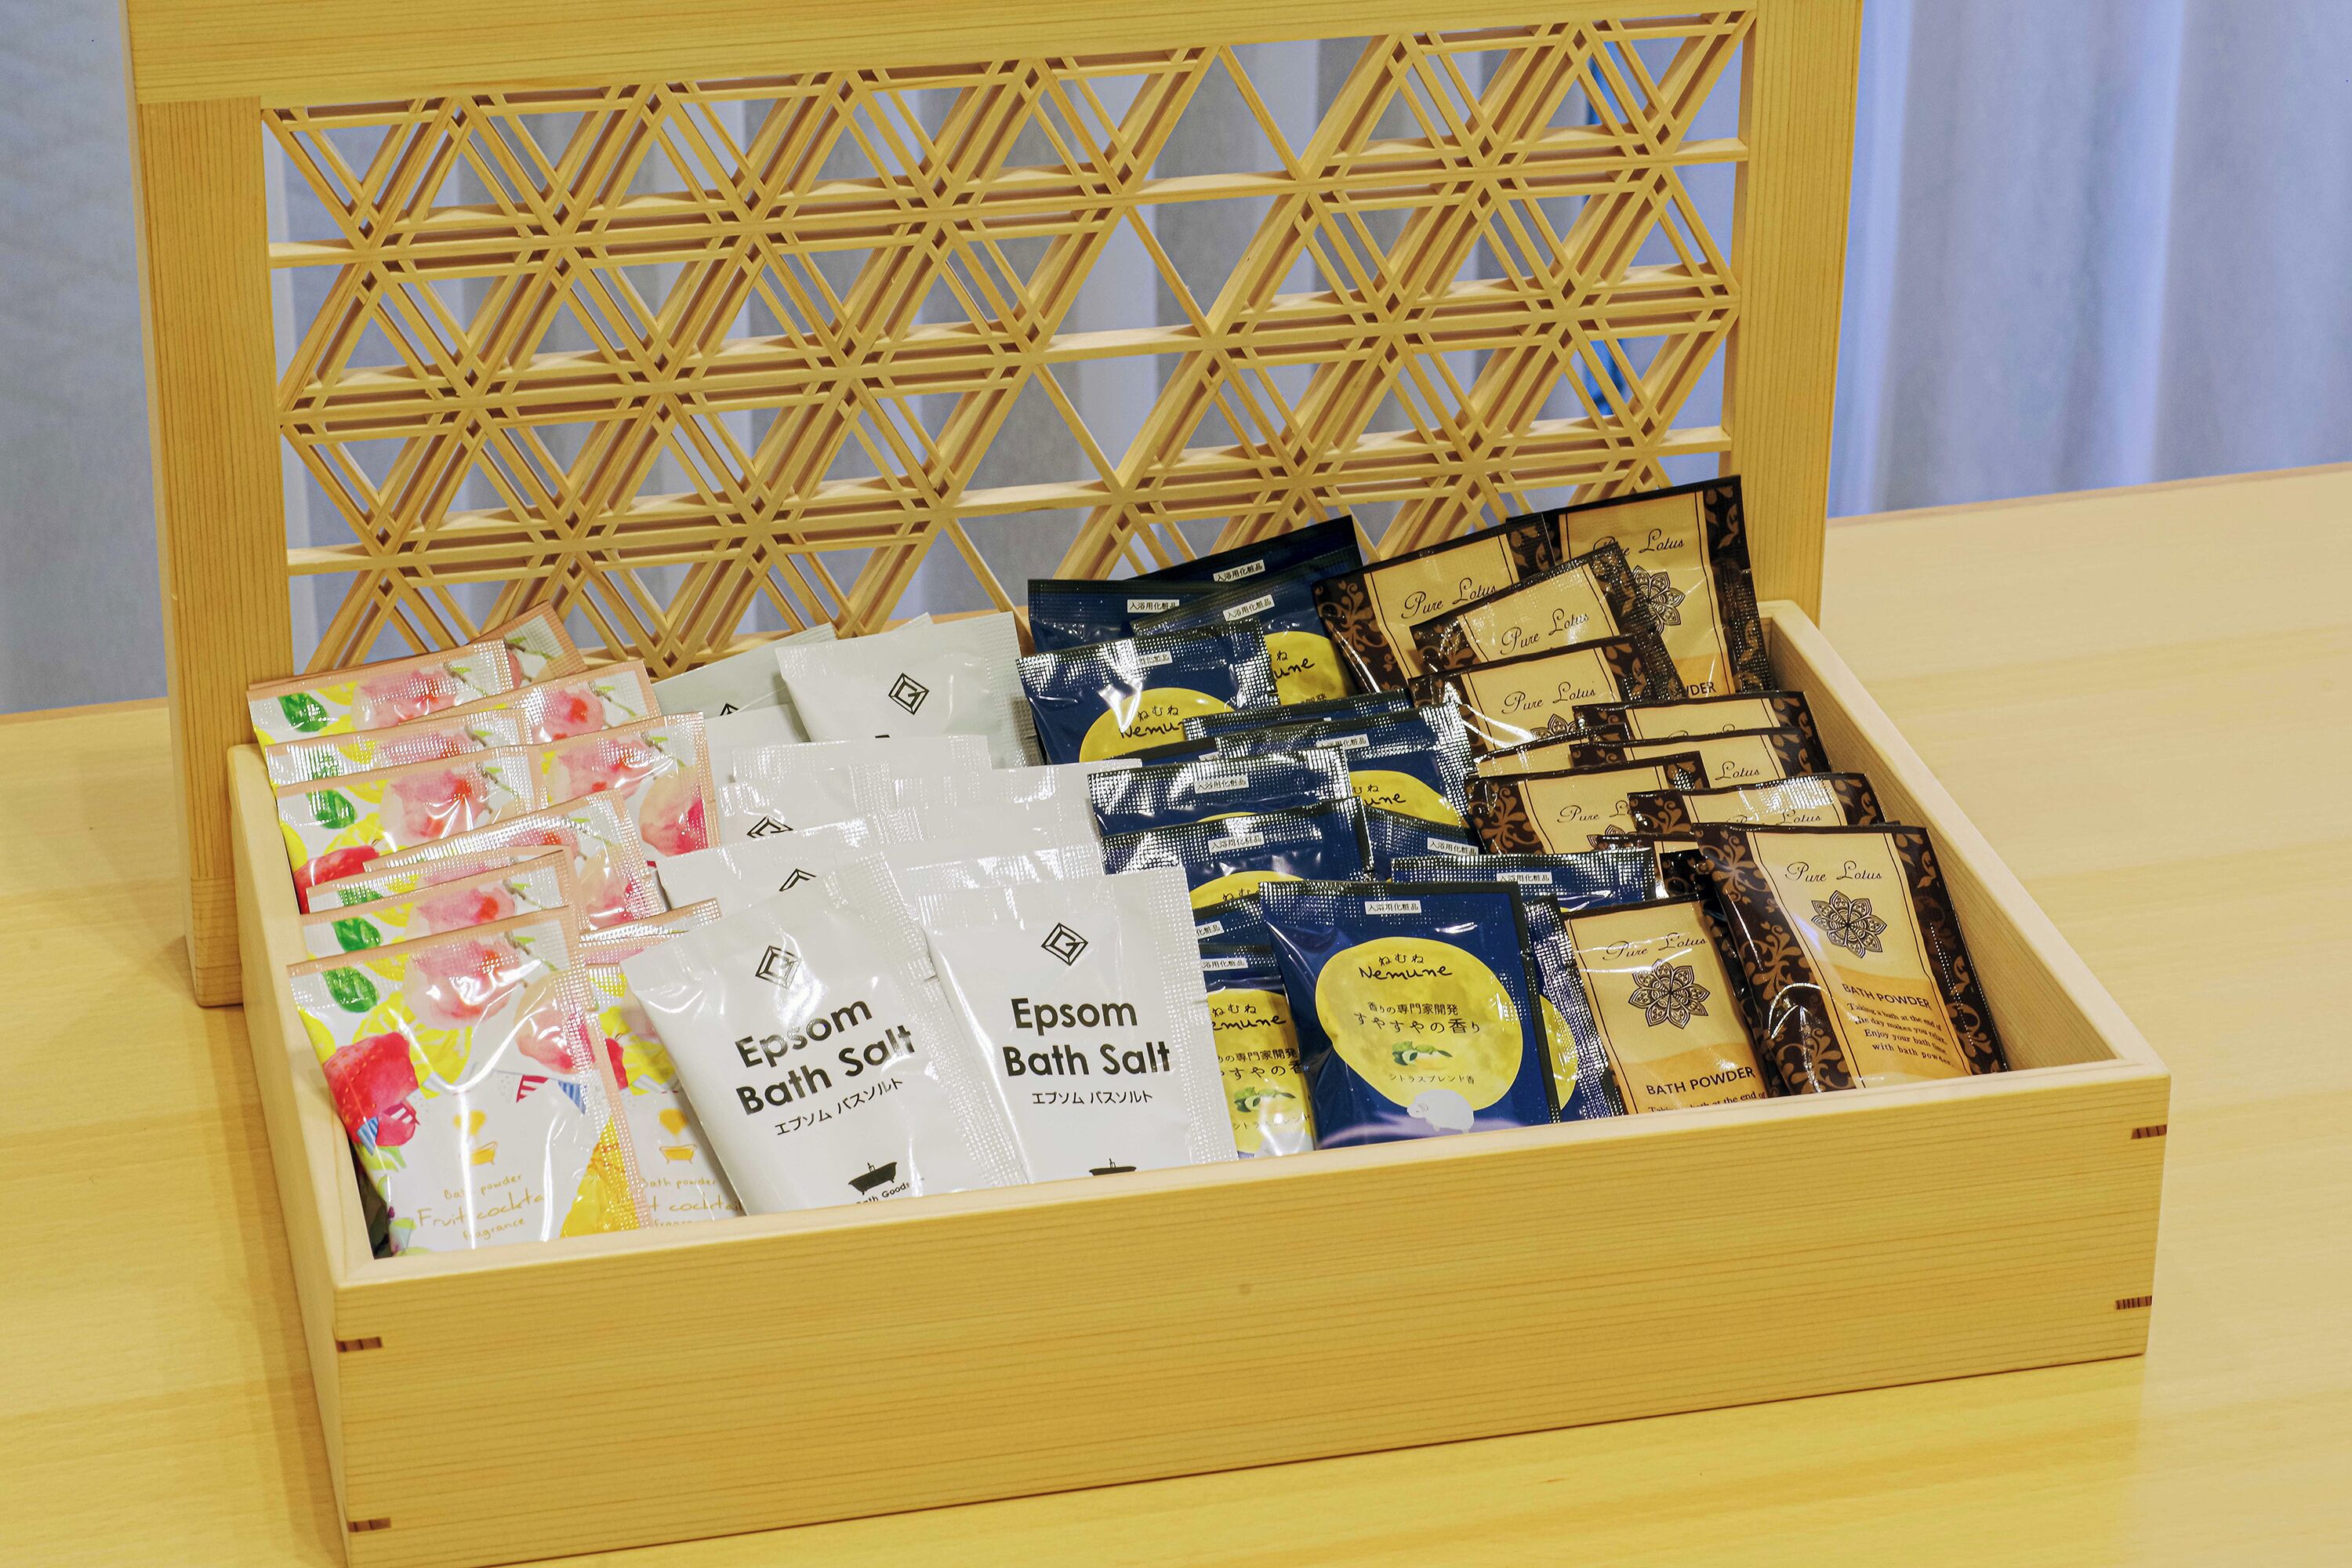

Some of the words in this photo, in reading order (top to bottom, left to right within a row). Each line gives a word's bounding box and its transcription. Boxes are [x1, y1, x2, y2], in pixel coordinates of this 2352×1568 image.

[1639, 528, 1685, 554] Lotus
[1227, 598, 1272, 619] 入浴用化粧品
[1401, 591, 1443, 619] Pure
[1501, 626, 1541, 655] Pure
[1548, 608, 1589, 635] Lotus
[1501, 691, 1544, 714] Pure
[1553, 681, 1596, 703] Lotus
[1715, 760, 1761, 780] Lotus
[1557, 804, 1599, 822] Pure
[1785, 861, 1827, 883] Pure
[1836, 860, 1883, 880] Lotus
[1602, 940, 1648, 961] Pure
[1658, 932, 1707, 951] Lotus
[1379, 953, 1424, 966] ねむね
[1359, 966, 1453, 980] Nemune
[1842, 983, 1875, 1000] BATH
[1876, 993, 1933, 1011] POWDER
[1011, 997, 1138, 1036] Epsom
[1212, 1004, 1257, 1017] ねむね
[1368, 1002, 1459, 1015] 香りの専門家開発
[1211, 1014, 1287, 1031] emune
[1354, 1012, 1480, 1033] すやすやの香り
[735, 1000, 873, 1068] Epsom
[1864, 1029, 1889, 1040] Enjoy
[1002, 1044, 1090, 1076] Bath
[1099, 1040, 1171, 1075] Salt
[1218, 1047, 1298, 1063] りの専門家開発
[1872, 1043, 1894, 1051] with
[1897, 1045, 1918, 1056] bath
[735, 1065, 832, 1116] Bath
[838, 1025, 915, 1077] Salt
[1646, 1081, 1686, 1094] BATH
[1690, 1066, 1756, 1090] POWDER
[775, 1109, 832, 1135] エプソム
[837, 1078, 902, 1114] バスソルト
[1032, 1091, 1084, 1105] エプソム
[1090, 1090, 1152, 1104] バスソルト
[481, 1174, 522, 1196] powder
[677, 1177, 716, 1189] powder
[417, 1207, 466, 1227] Fruit
[463, 1218, 525, 1240] fagrance
